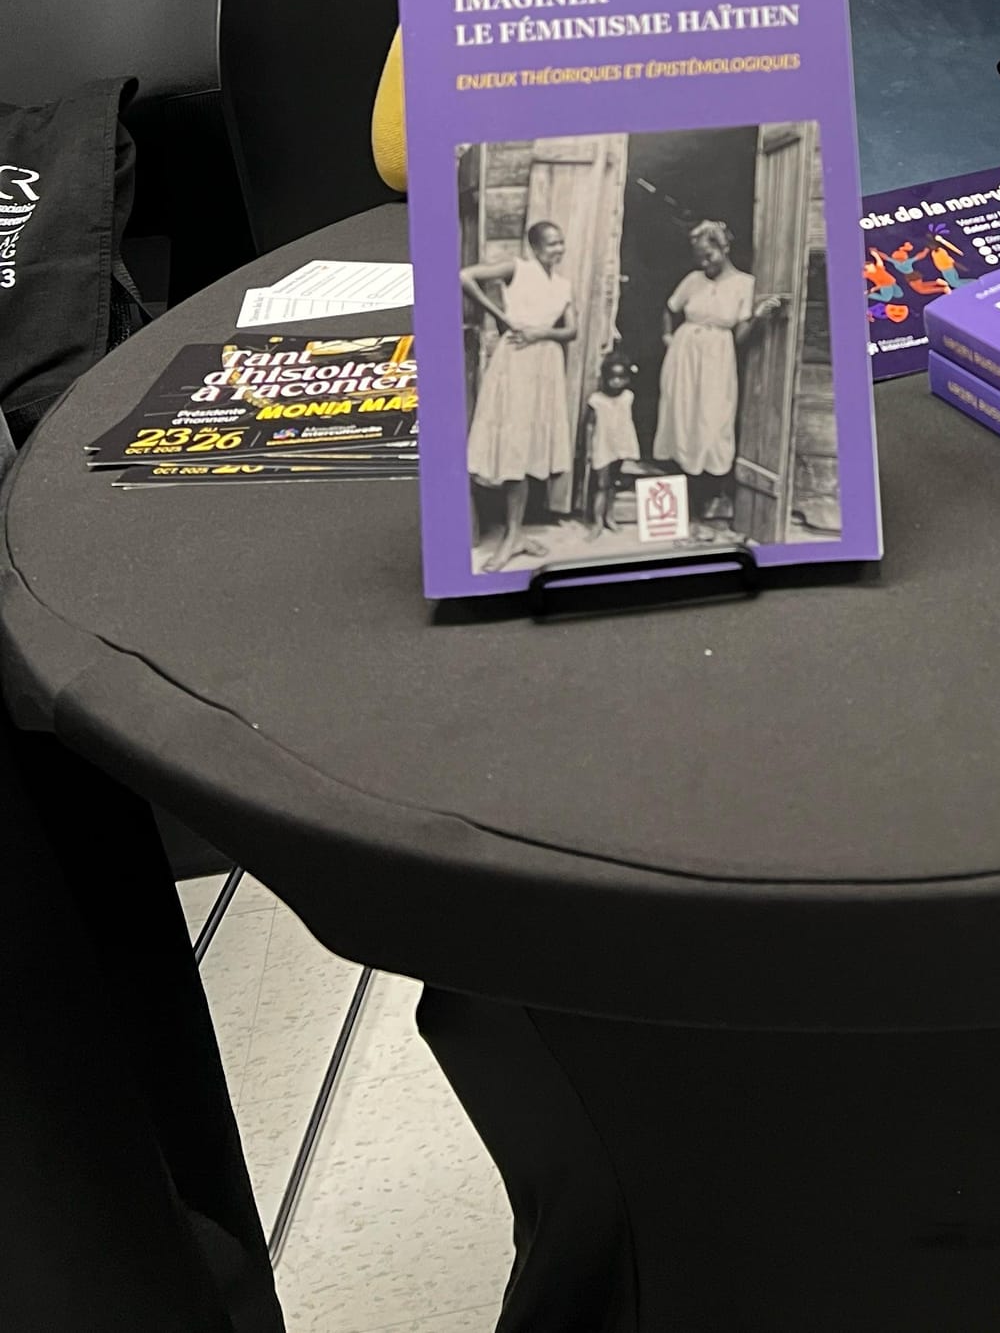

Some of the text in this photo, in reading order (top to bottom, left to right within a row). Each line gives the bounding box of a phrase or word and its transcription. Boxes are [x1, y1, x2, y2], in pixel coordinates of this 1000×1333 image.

[455, 4, 800, 46] LE FÉMINISME HAÏTIEN
[456, 53, 801, 91] ENJEUX THÉORIQUES ET ÉPISTÉMOLOGIQUES
[894, 204, 923, 222] de
[923, 199, 946, 216] la
[223, 350, 312, 367] Tant
[204, 360, 418, 385] d'histoires
[230, 373, 418, 400] raconter
[256, 400, 352, 420] MONIA
[130, 427, 192, 447] 23
[186, 431, 244, 451] 26
